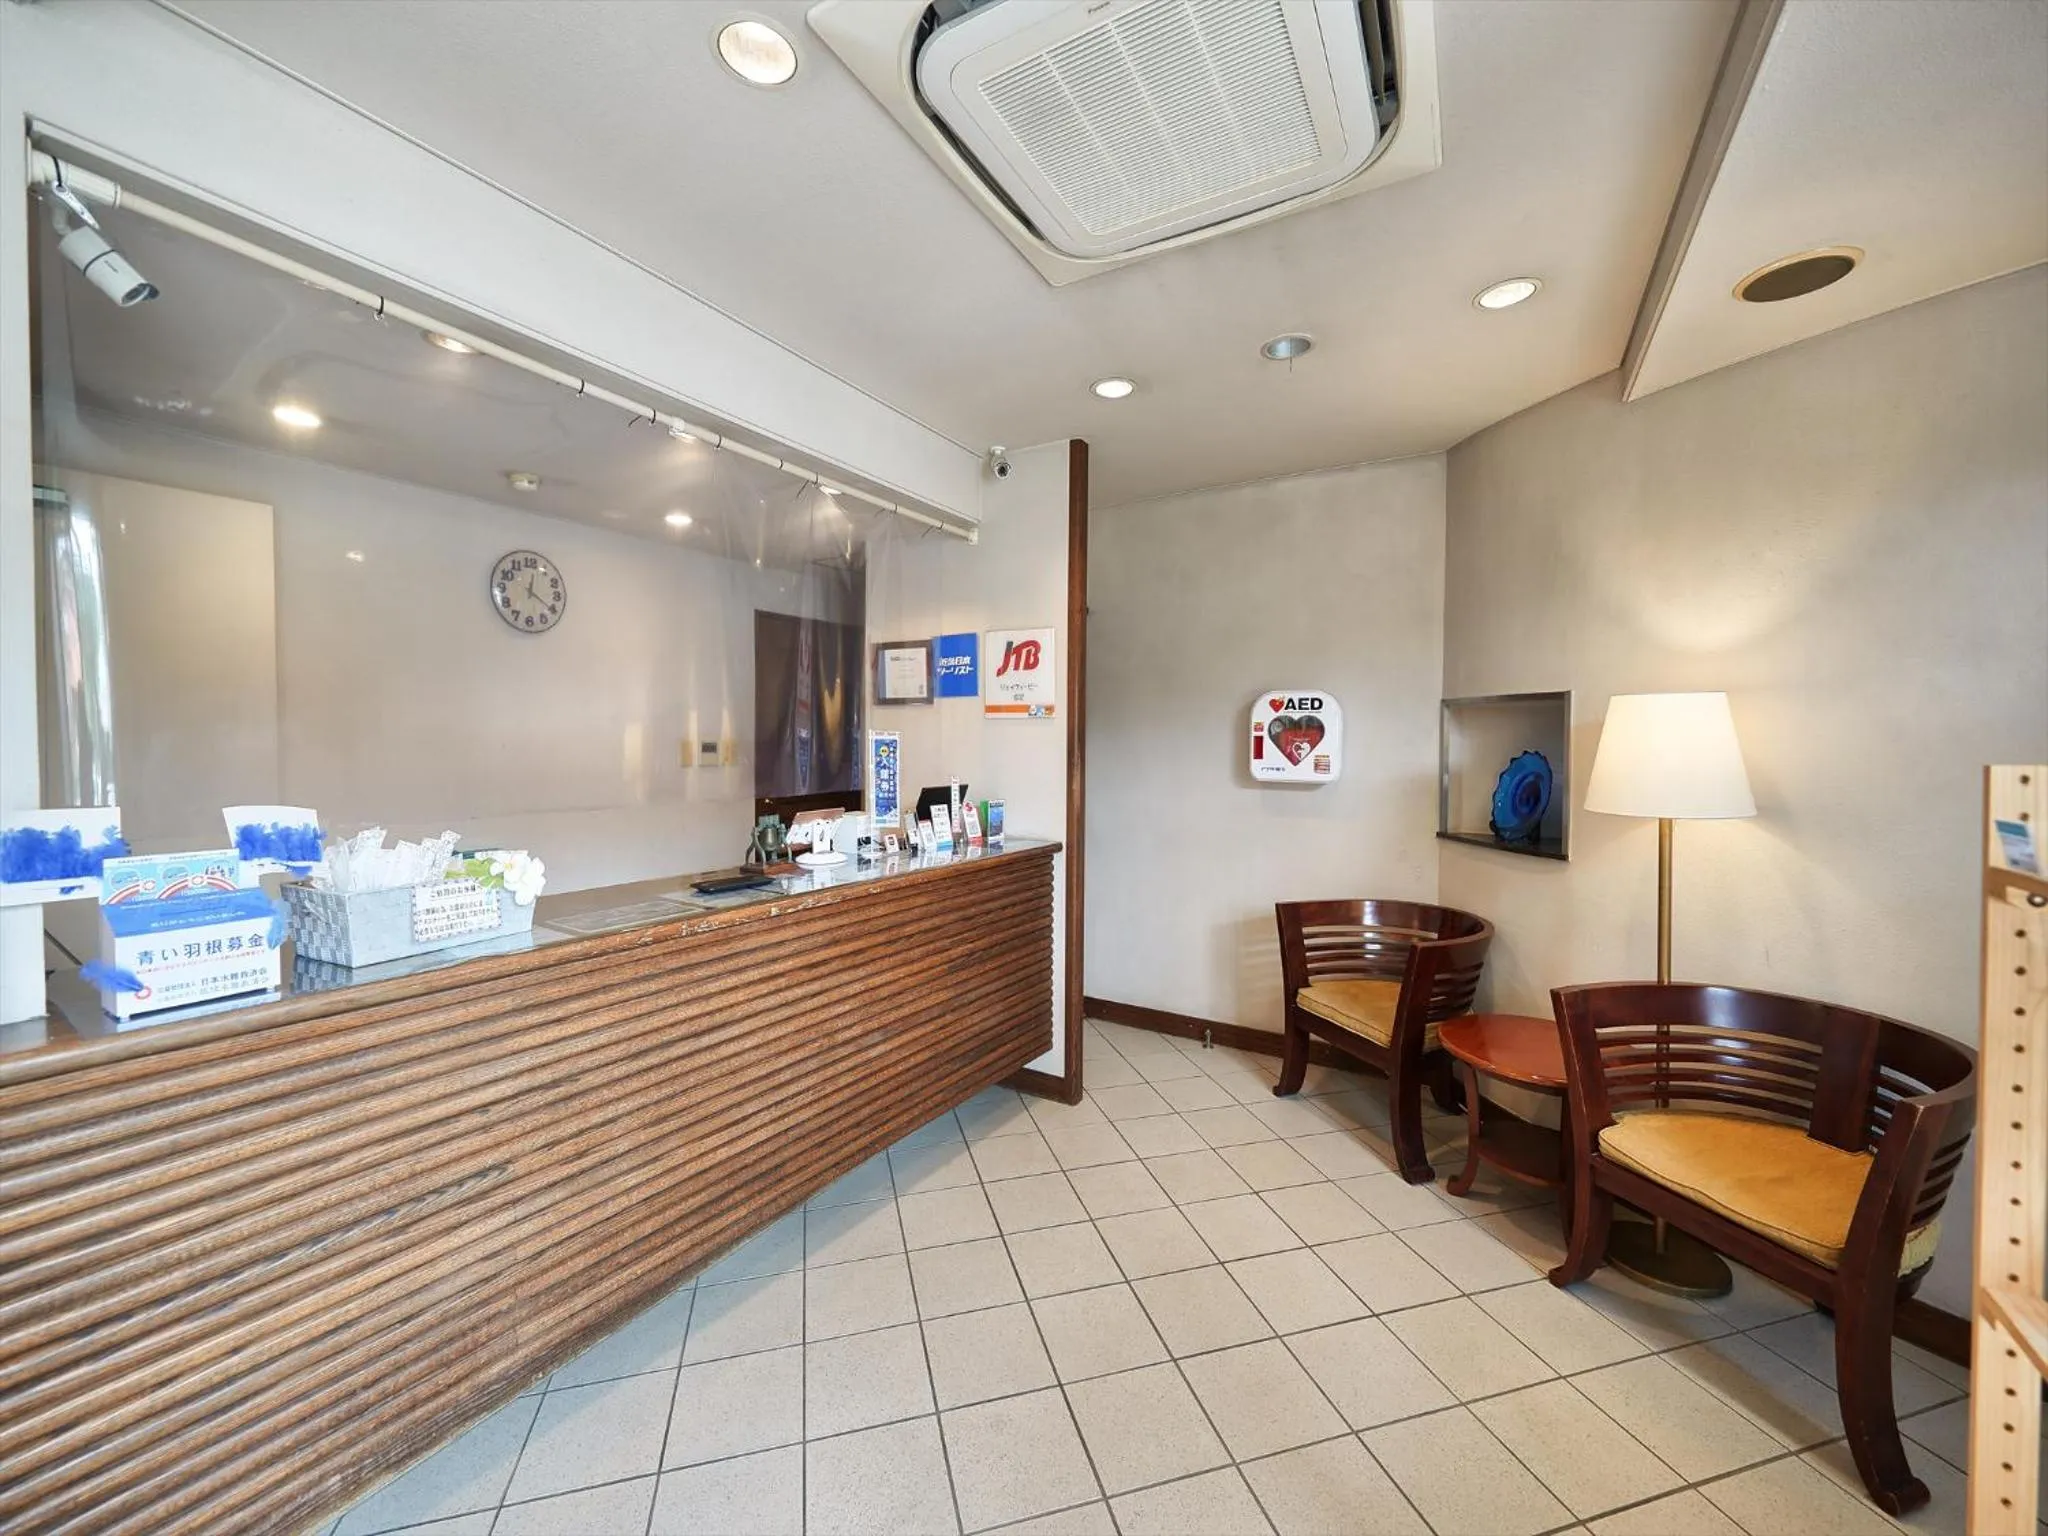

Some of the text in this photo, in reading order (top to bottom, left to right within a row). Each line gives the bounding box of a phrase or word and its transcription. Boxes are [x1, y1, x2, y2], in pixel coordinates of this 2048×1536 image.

[511, 559, 522, 571] 11
[523, 556, 538, 569] 12
[501, 568, 514, 582] 10
[497, 582, 506, 593] 9
[550, 577, 559, 589] 2
[502, 596, 511, 608] 8
[552, 591, 562, 602] 3
[511, 609, 521, 622] 7
[525, 615, 534, 627] 6
[996, 640, 1042, 678] JTB
[1284, 697, 1324, 711] AED
[136, 933, 265, 967] 青い羽根募金
